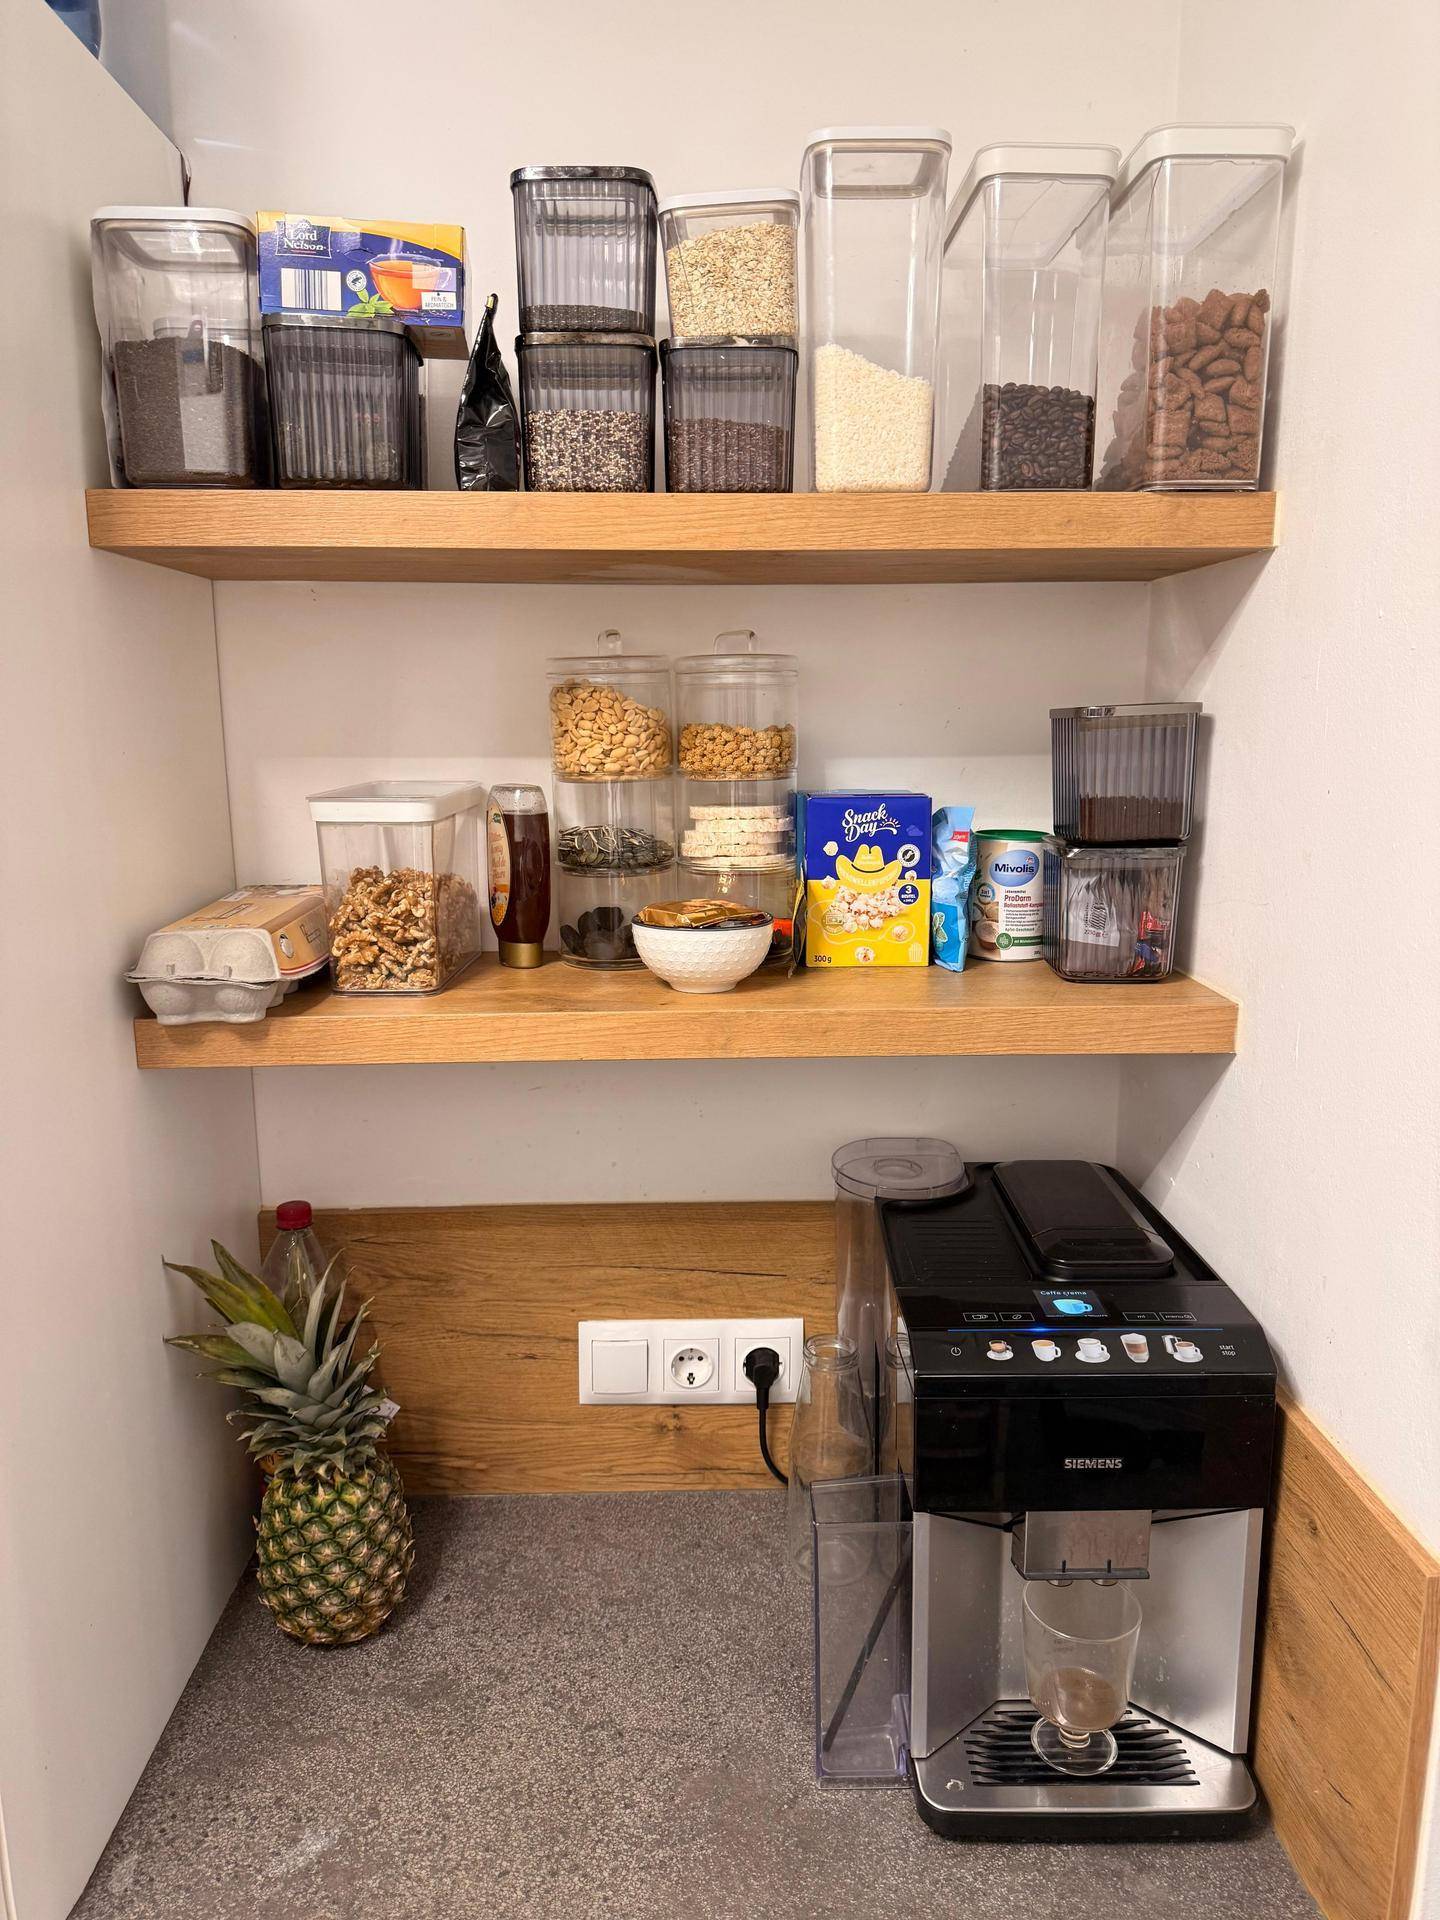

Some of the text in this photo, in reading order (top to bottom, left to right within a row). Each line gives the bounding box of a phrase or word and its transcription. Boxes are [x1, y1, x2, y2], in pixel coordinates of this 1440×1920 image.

[289, 229, 318, 241] Lord
[283, 238, 324, 251] Nelson
[842, 803, 888, 828] Snack
[844, 821, 892, 843] Day
[994, 863, 1035, 874] Mivolis
[905, 885, 912, 894] 3
[813, 955, 832, 964] 300 g
[1064, 1458, 1123, 1469] SIEMENS
